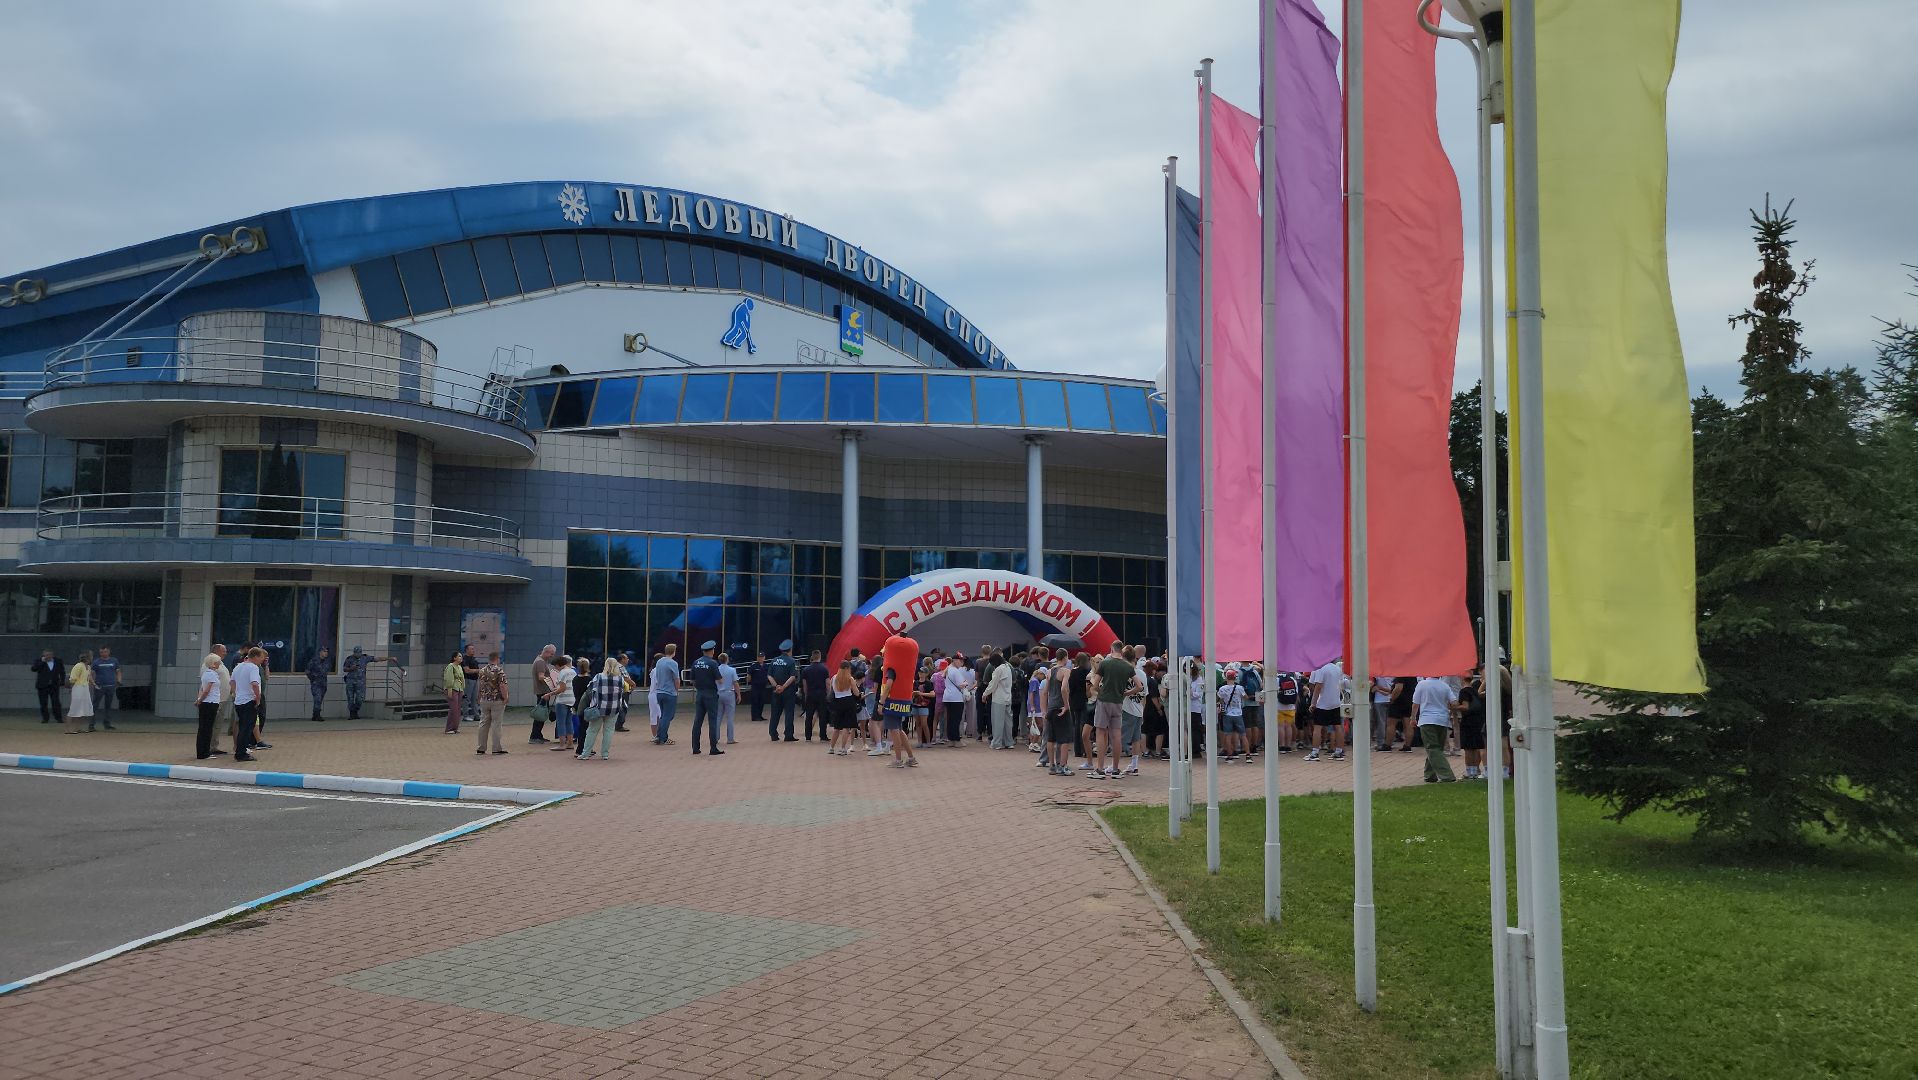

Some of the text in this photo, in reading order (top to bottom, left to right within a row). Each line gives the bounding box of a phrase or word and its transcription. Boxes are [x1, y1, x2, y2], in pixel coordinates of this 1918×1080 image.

[614, 188, 799, 250] ЛЕДОВЫЙ
[825, 235, 927, 316] ДВОРЕЦ
[883, 611, 907, 636] С
[905, 580, 1082, 627] ПРАЗДНИКОМ
